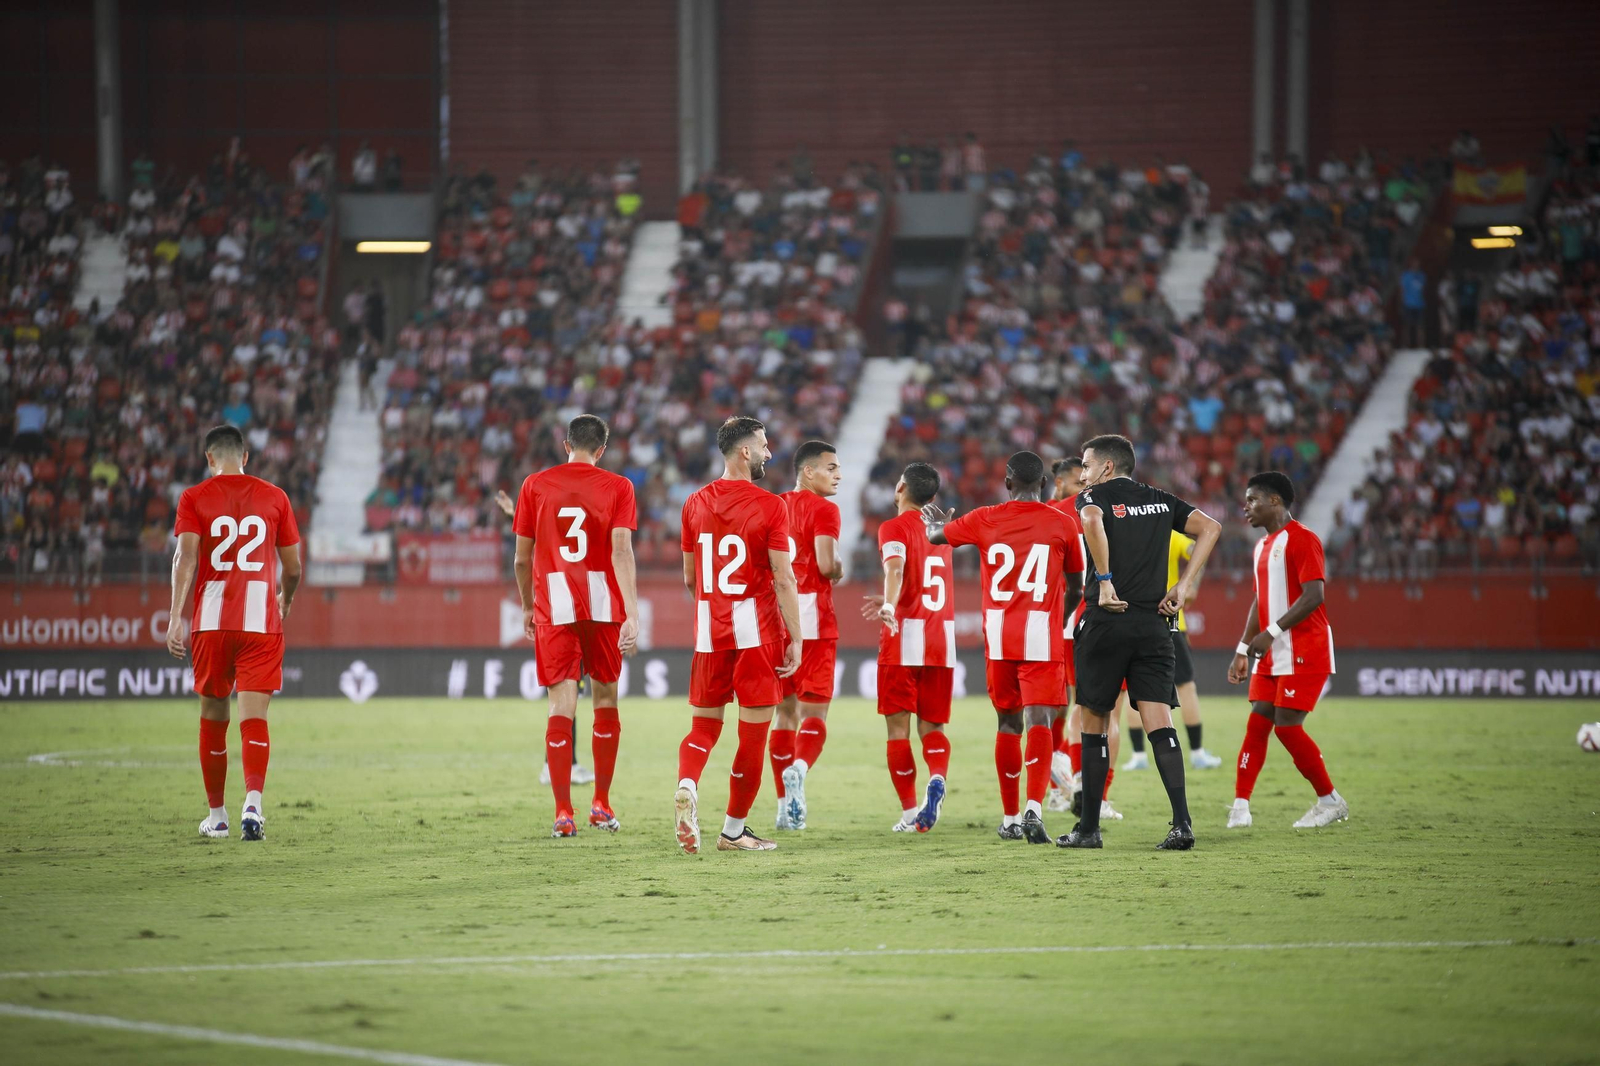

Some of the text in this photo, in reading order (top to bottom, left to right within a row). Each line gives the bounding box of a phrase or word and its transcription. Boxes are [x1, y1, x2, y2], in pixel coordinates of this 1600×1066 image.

[557, 507, 587, 563] 3
[1126, 503, 1170, 517] WÜRTH
[210, 515, 267, 572] 22
[697, 533, 747, 595] 12
[921, 556, 946, 611] 5
[987, 543, 1050, 602] 24
[0, 615, 143, 644] utomotor
[1358, 667, 1526, 696] SCIENTIFFIC
